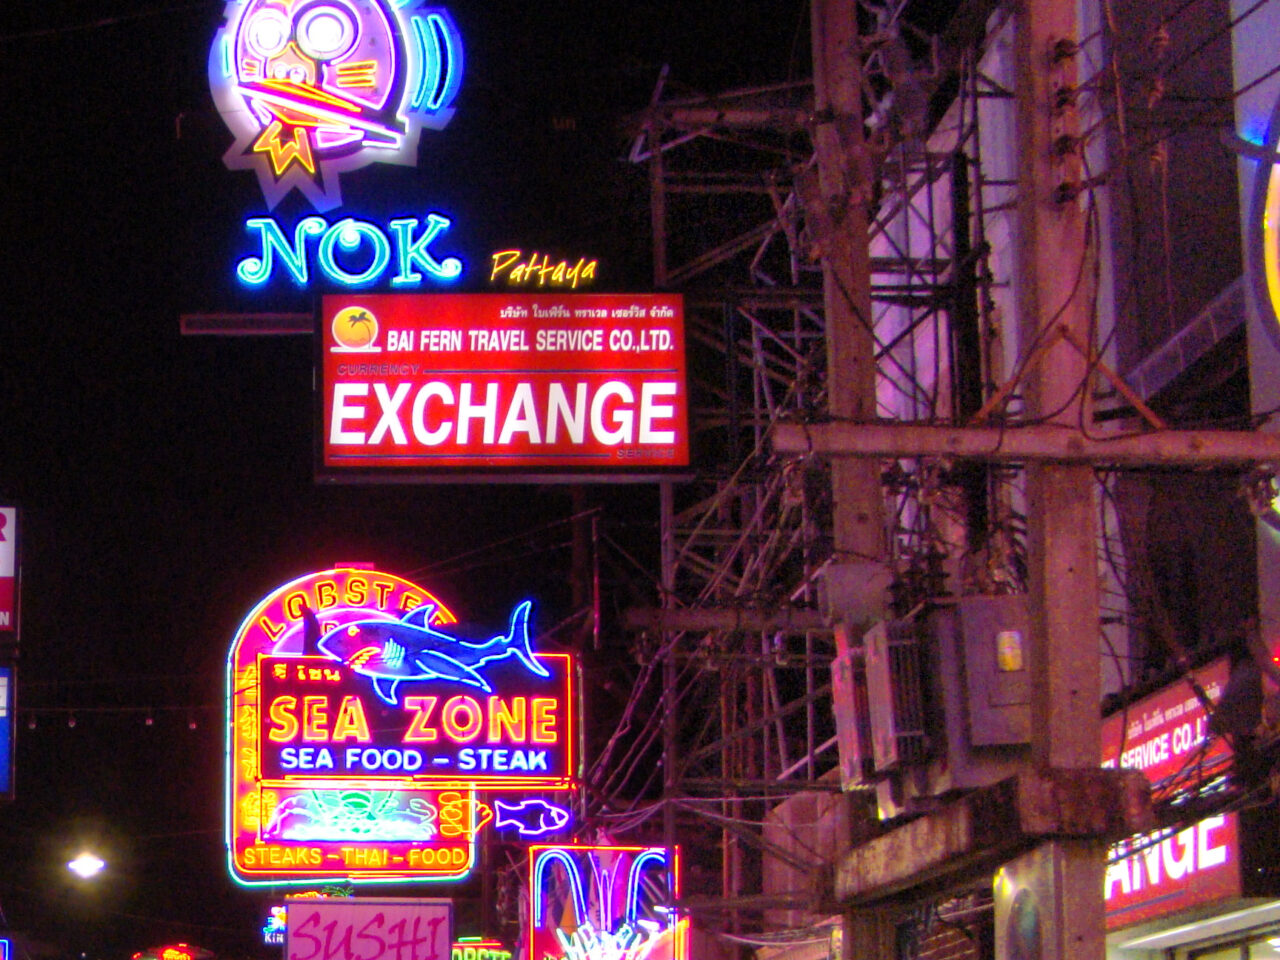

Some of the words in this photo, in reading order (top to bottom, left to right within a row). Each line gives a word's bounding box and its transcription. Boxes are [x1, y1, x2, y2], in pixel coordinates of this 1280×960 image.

[238, 214, 462, 285] NOK
[490, 249, 598, 287] Pattaya
[387, 330, 414, 351] BAI
[420, 330, 462, 351] FERN
[468, 330, 529, 352] TRAVEL
[535, 330, 603, 352] SERVICE
[609, 330, 675, 354] CO.,LTD.
[337, 363, 420, 376] CURRENCY
[329, 381, 678, 446] EXCHANGE
[615, 448, 676, 459] SERVICE
[268, 695, 372, 743] SEA
[402, 695, 558, 744] ZONE
[280, 748, 334, 770] SEA
[345, 748, 422, 771] FOOD
[459, 750, 548, 771] STEAK
[243, 848, 322, 866] STEAKS
[343, 848, 388, 865] THAI
[409, 848, 466, 865] FOOD
[1104, 814, 1228, 901] ANGE
